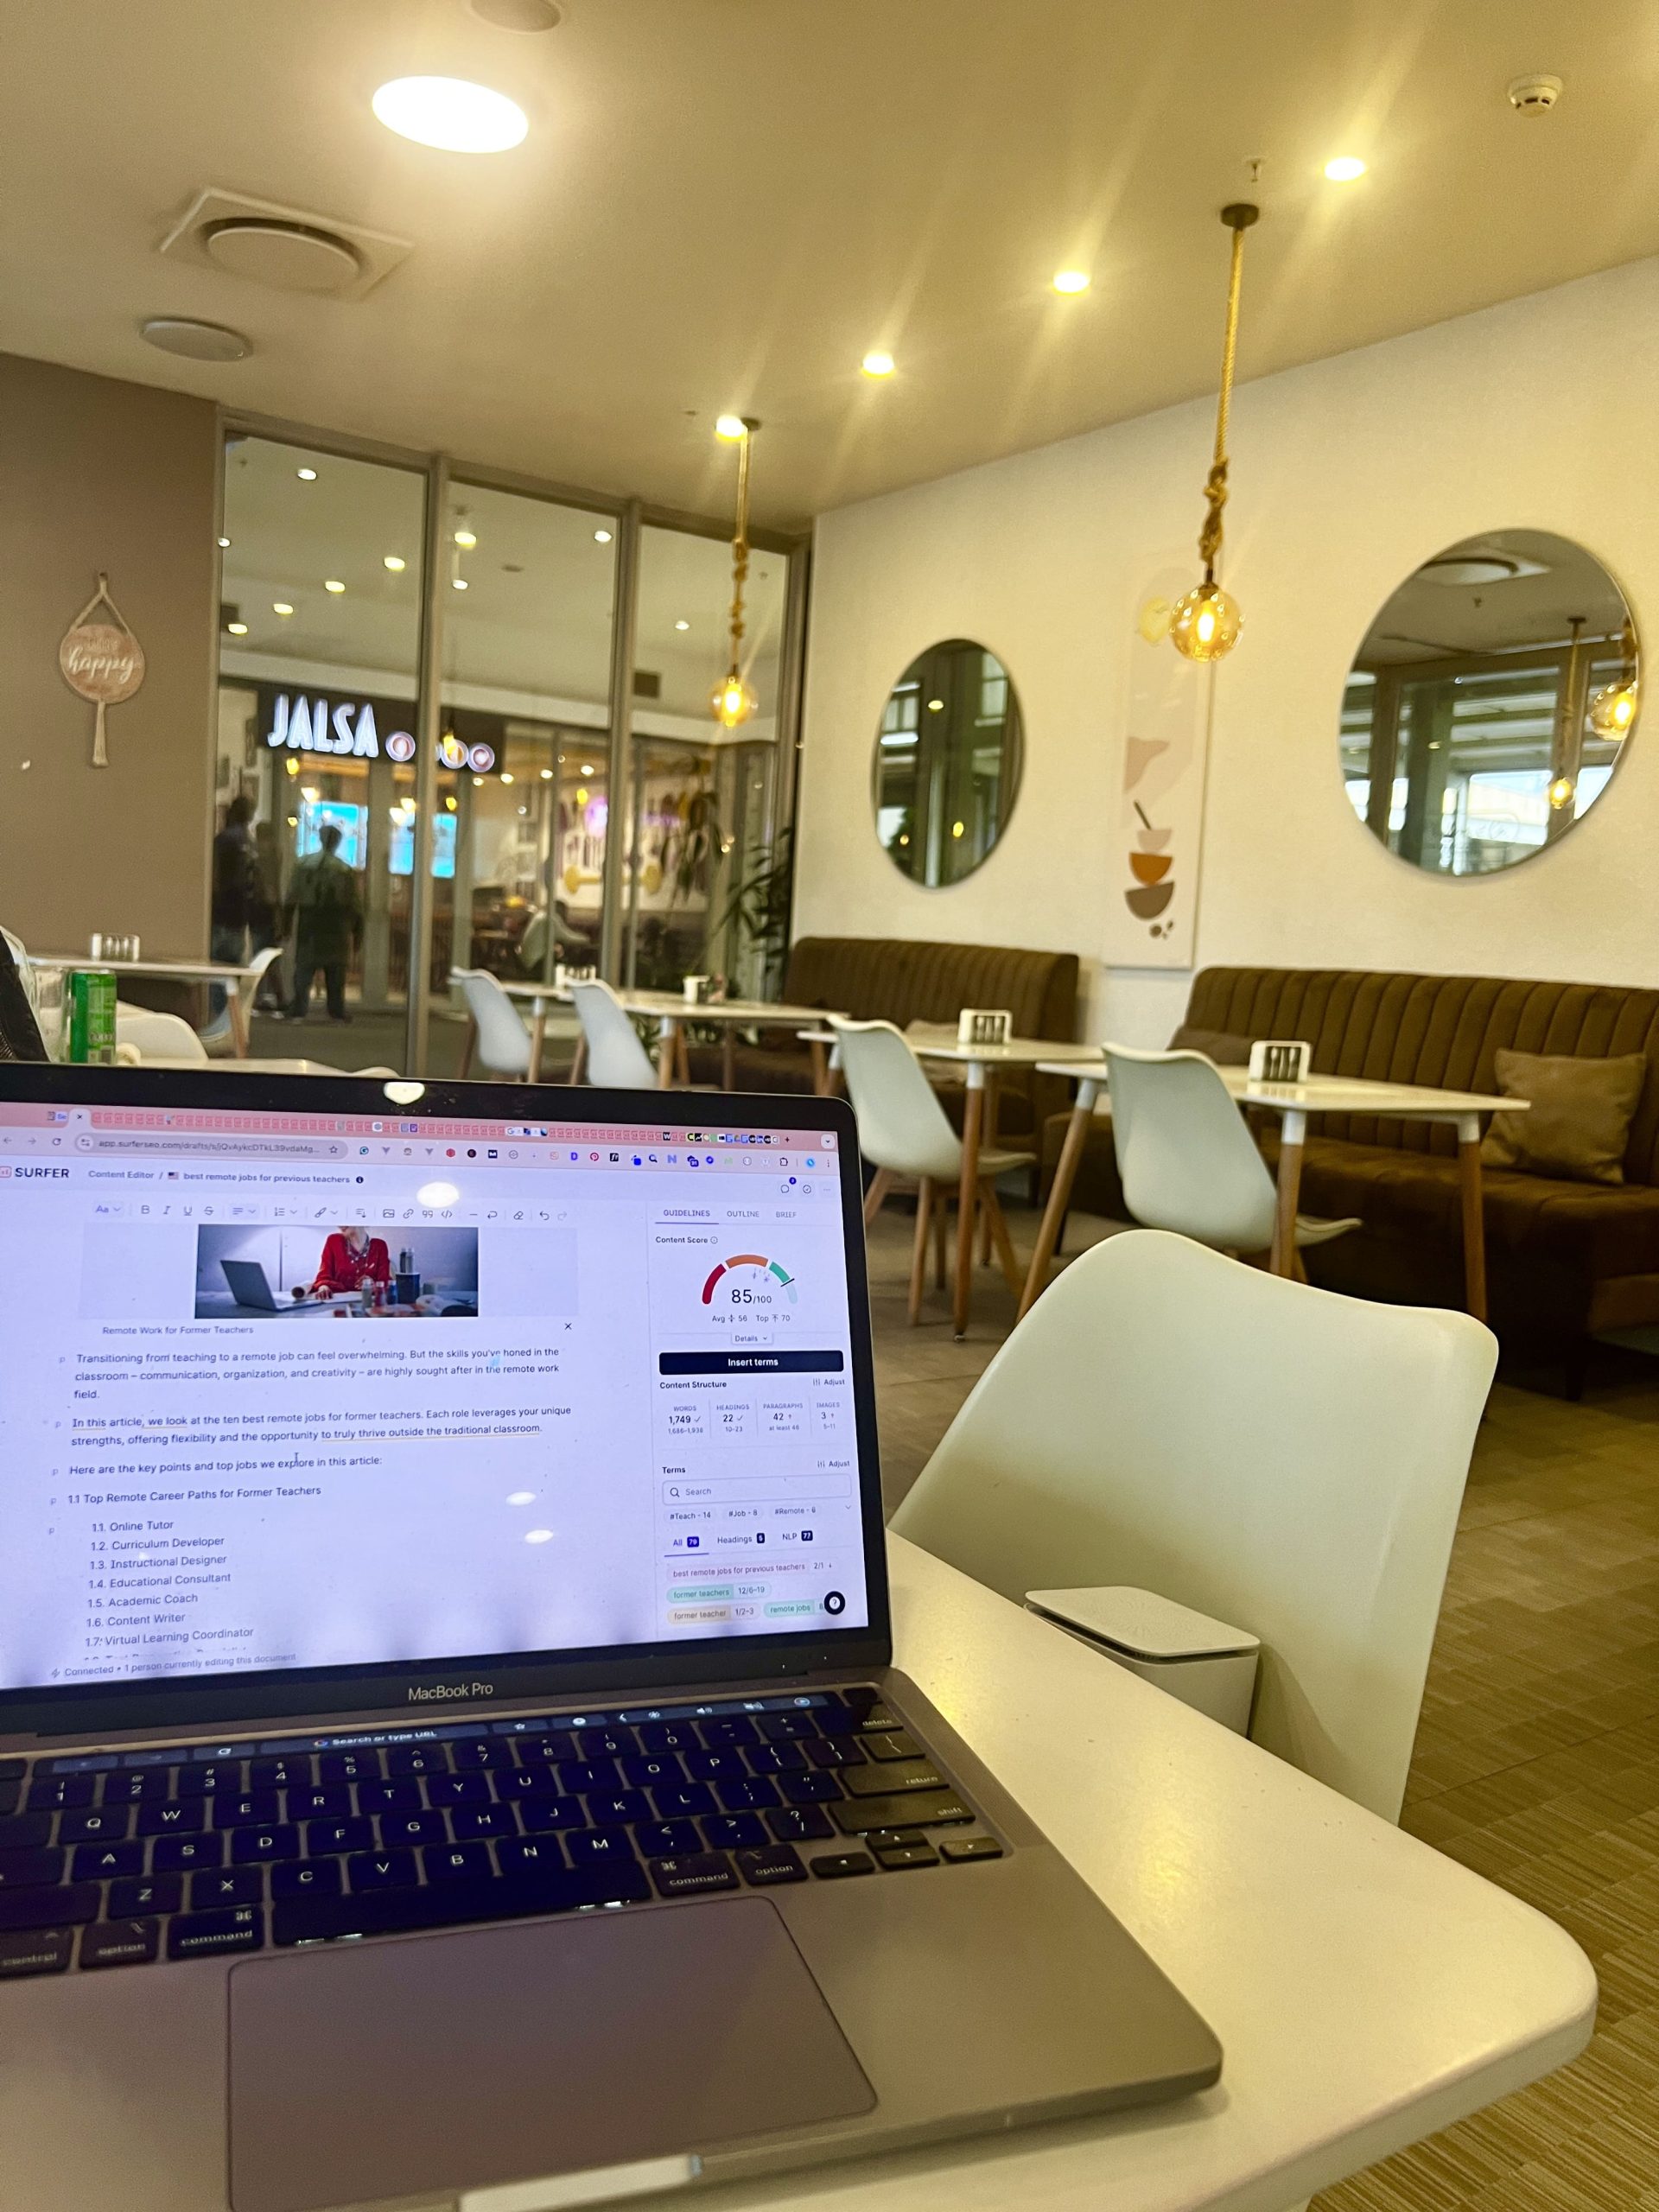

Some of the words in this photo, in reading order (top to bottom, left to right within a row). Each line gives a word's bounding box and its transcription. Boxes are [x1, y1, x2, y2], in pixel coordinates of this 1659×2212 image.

[68, 645, 134, 683] happy
[267, 693, 378, 758] JALSA
[15, 1167, 69, 1179] SURFER
[127, 1171, 154, 1179] Editor
[238, 1173, 257, 1183] jobs
[180, 1325, 211, 1334] Former
[214, 1325, 253, 1334] Teachers
[77, 1353, 143, 1365] Transitioning
[146, 1353, 169, 1362] from
[173, 1353, 216, 1364] teaching
[219, 1353, 229, 1362] to
[241, 1352, 276, 1361] remote
[278, 1351, 295, 1363] job
[318, 1351, 335, 1361] feel
[338, 1351, 407, 1361] overwhelming.
[410, 1350, 425, 1359] But
[429, 1350, 443, 1358] the
[447, 1350, 468, 1358] skills
[504, 1348, 531, 1357] honed
[534, 1348, 542, 1357] in
[544, 1348, 559, 1357] the
[728, 1358, 752, 1367] Insert
[75, 1372, 128, 1382] classroom
[140, 1370, 219, 1380] communication,
[223, 1369, 287, 1381] organization,
[290, 1369, 308, 1377] and
[311, 1368, 356, 1378] creativity
[385, 1367, 413, 1378] highly
[416, 1366, 448, 1376] sought
[450, 1365, 473, 1375] after
[475, 1365, 483, 1374] in
[504, 1365, 535, 1374] remote
[537, 1363, 559, 1372] work
[74, 1389, 99, 1399] field.
[73, 1418, 84, 1427] In
[87, 1418, 106, 1430] this
[110, 1417, 144, 1428] article,
[166, 1416, 188, 1425] look
[191, 1416, 200, 1426] at
[204, 1416, 219, 1425] the
[242, 1414, 264, 1424] best
[267, 1414, 302, 1423] remote
[304, 1413, 326, 1424] jobs
[328, 1413, 342, 1421] for
[345, 1412, 377, 1421] former
[380, 1411, 423, 1420] teachers.
[427, 1409, 449, 1419] Each
[452, 1409, 469, 1418] role
[472, 1409, 516, 1419] leverages
[518, 1408, 538, 1418] your
[541, 1407, 570, 1415] unique
[669, 1415, 690, 1425] 1,749
[72, 1436, 124, 1447] strengths,
[128, 1435, 168, 1446] offering
[171, 1433, 216, 1445] flexibility
[219, 1433, 238, 1442] and
[242, 1433, 257, 1442] the
[261, 1431, 318, 1442] opportunity
[334, 1429, 355, 1440] truly
[359, 1429, 385, 1438] thrive
[389, 1427, 423, 1437] outside
[427, 1427, 442, 1436] the
[445, 1425, 491, 1435] traditional
[493, 1425, 542, 1433] classroom.
[68, 1494, 79, 1503] 1.1
[84, 1494, 104, 1504] Top
[106, 1493, 147, 1503] Remote
[149, 1491, 184, 1501] Career
[188, 1490, 217, 1500] Paths
[220, 1489, 233, 1498] for
[238, 1488, 273, 1497] Former
[276, 1486, 321, 1497] Teachers
[92, 1522, 106, 1532] 1.1.
[110, 1522, 143, 1532] Online
[147, 1520, 174, 1530] Tutor
[92, 1541, 108, 1552] 1.2.
[111, 1539, 168, 1551] Curriculum
[172, 1537, 224, 1548] Developer
[717, 1535, 752, 1544] Headings
[90, 1560, 106, 1570] 1.3.
[111, 1556, 178, 1569] Instructional
[181, 1554, 227, 1567] Designer
[89, 1579, 106, 1590] 1.4.
[110, 1576, 172, 1589] Educational
[175, 1573, 231, 1585] Consultant
[88, 1598, 105, 1608] 1.5.
[108, 1595, 161, 1607] Academic
[164, 1592, 198, 1605] Coach
[87, 1618, 104, 1628] 1.6.
[106, 1616, 150, 1627] Content
[154, 1612, 186, 1624] Writer
[105, 1634, 140, 1646] Virtual
[143, 1631, 189, 1644] Learning
[192, 1628, 253, 1640] Coordinator
[409, 1685, 468, 1700] MacBook
[472, 1683, 493, 1695] Pro
[333, 1736, 371, 1745] Search
[388, 1732, 413, 1742] type
[415, 1730, 437, 1738] URL
[162, 1809, 181, 1821] W
[938, 1807, 962, 1815] shift
[407, 1821, 420, 1831] G
[478, 1815, 491, 1825] H
[259, 1837, 272, 1847] D
[592, 1838, 608, 1849] M
[451, 1854, 463, 1866] B
[755, 1864, 793, 1875] option
[669, 1872, 728, 1886] command
[179, 1929, 252, 1947] command
